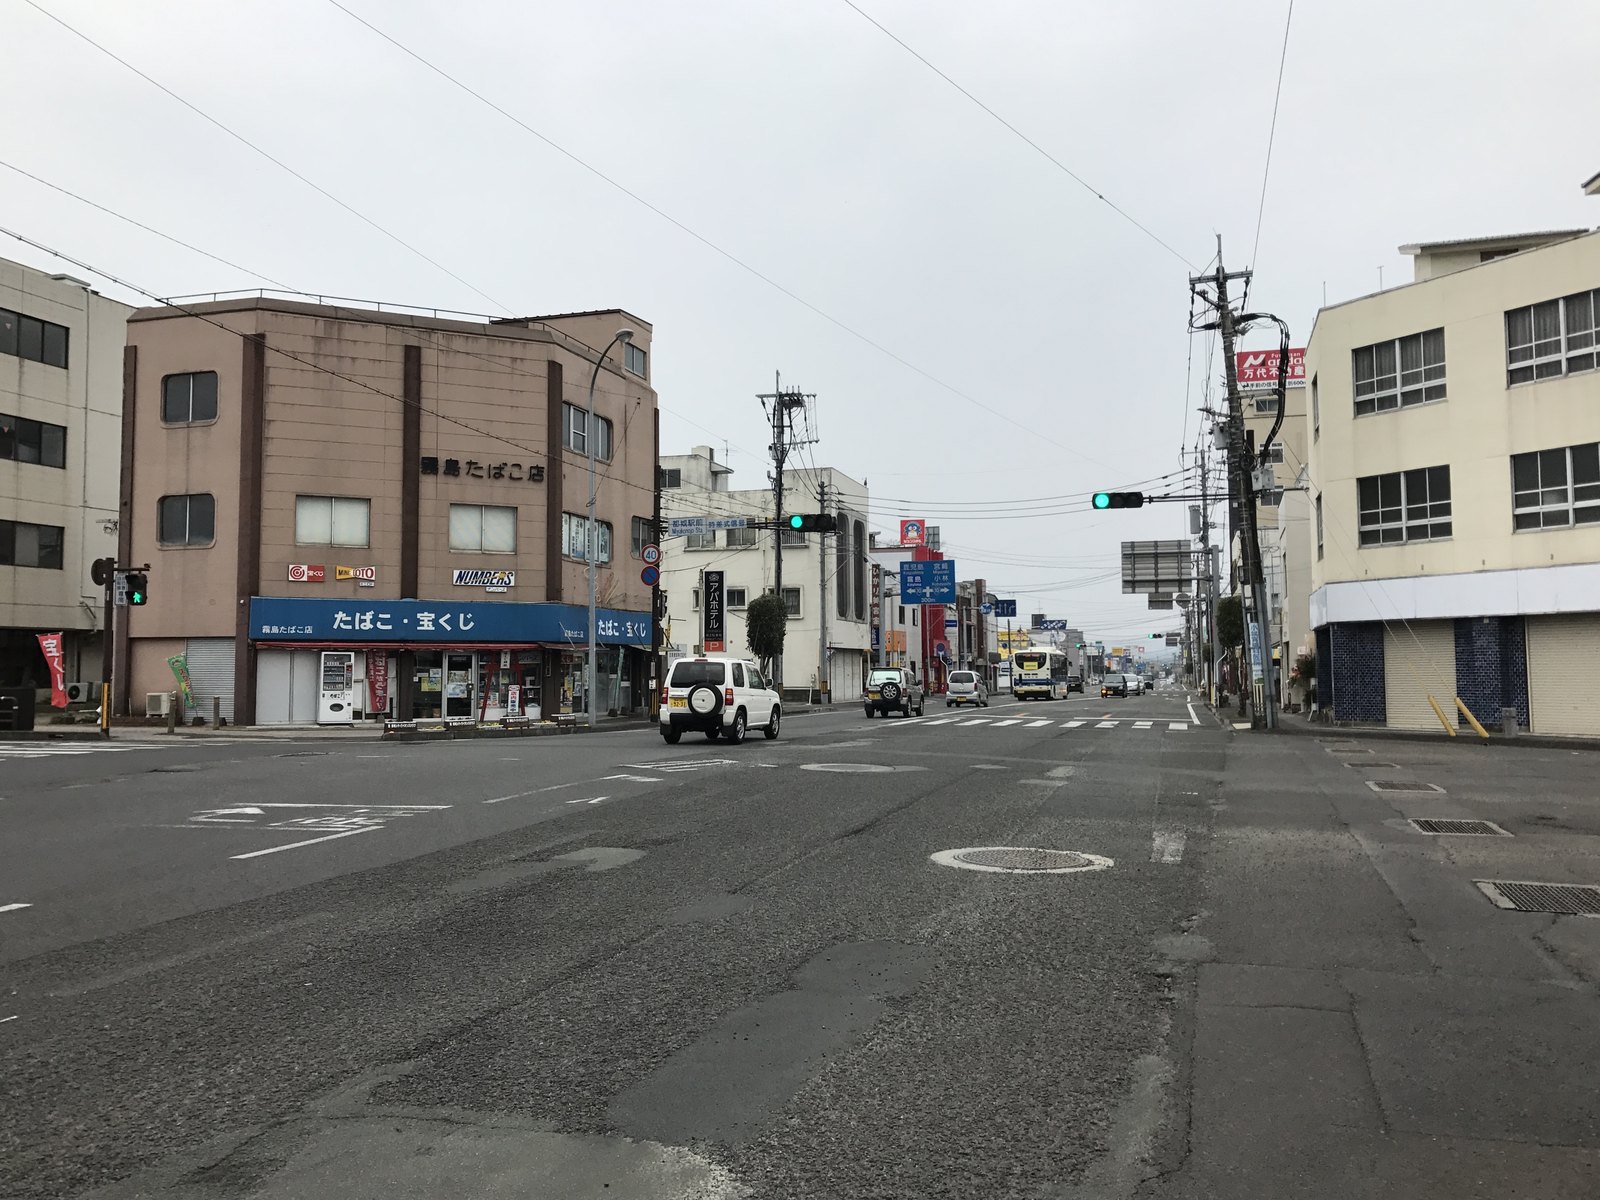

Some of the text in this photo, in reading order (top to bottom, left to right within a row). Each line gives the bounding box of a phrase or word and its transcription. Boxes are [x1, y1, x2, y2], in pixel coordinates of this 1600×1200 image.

[645, 550, 657, 560] 40
[454, 570, 514, 586] NUMBERS
[709, 582, 720, 629] アパホテル
[332, 610, 476, 632] たばこ・宝くじ
[261, 625, 314, 634] 霧島たばこ店
[709, 641, 719, 651] P
